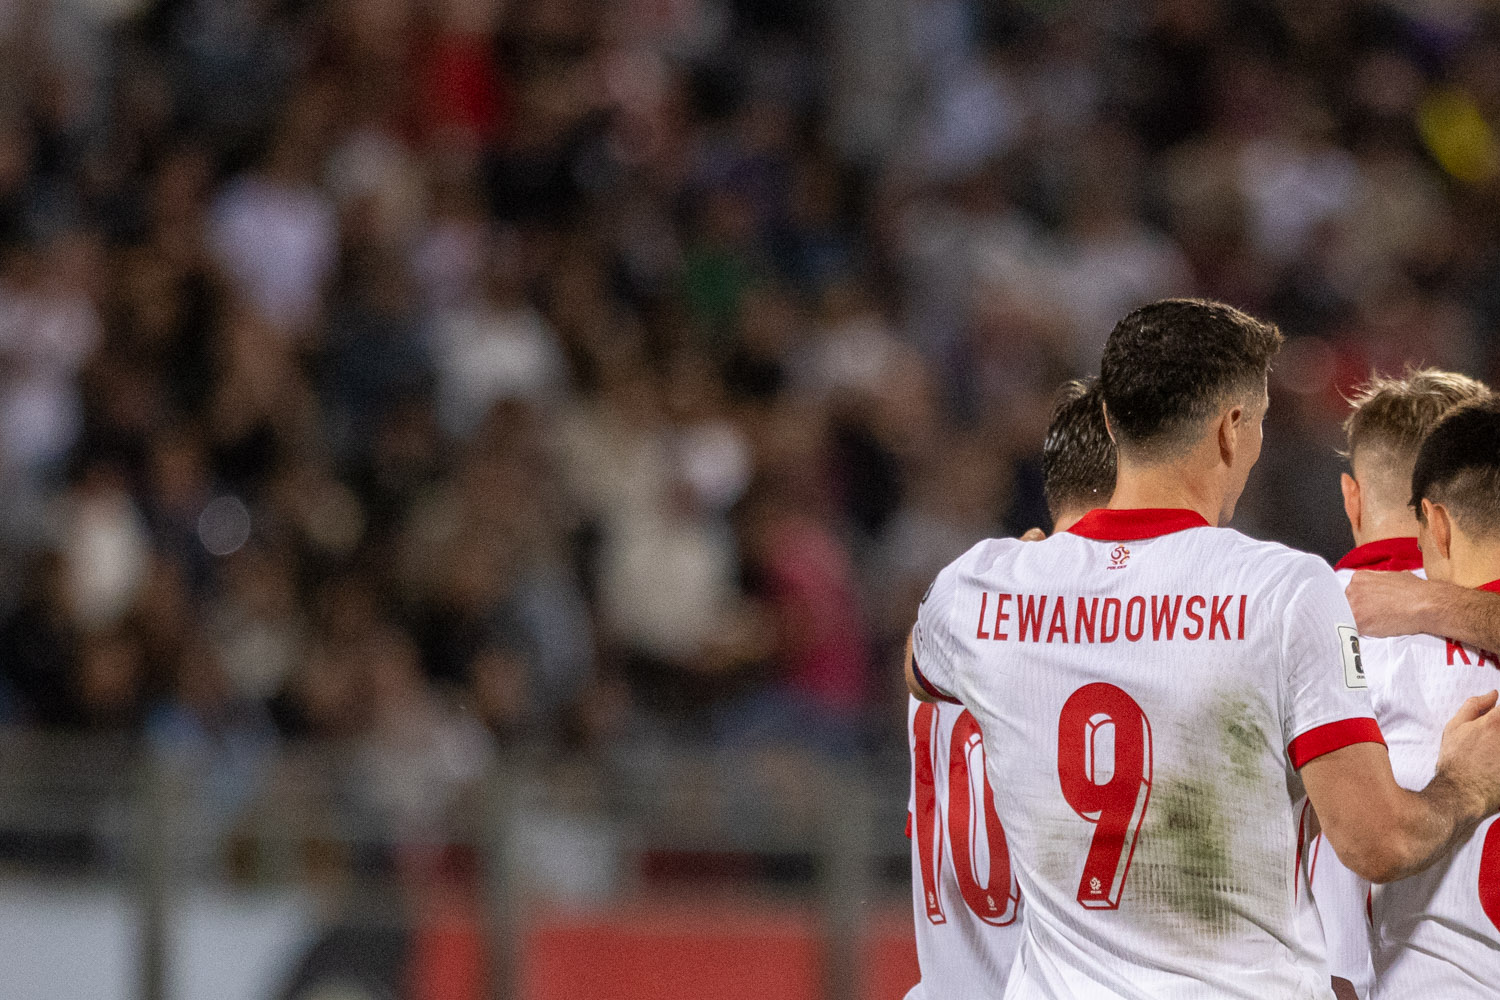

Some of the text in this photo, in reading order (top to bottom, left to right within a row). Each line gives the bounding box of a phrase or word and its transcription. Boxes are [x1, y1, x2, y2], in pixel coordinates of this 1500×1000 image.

[976, 591, 1248, 643] LEWANDOWSKI
[913, 701, 1021, 926] 10
[1057, 682, 1153, 910] 9
